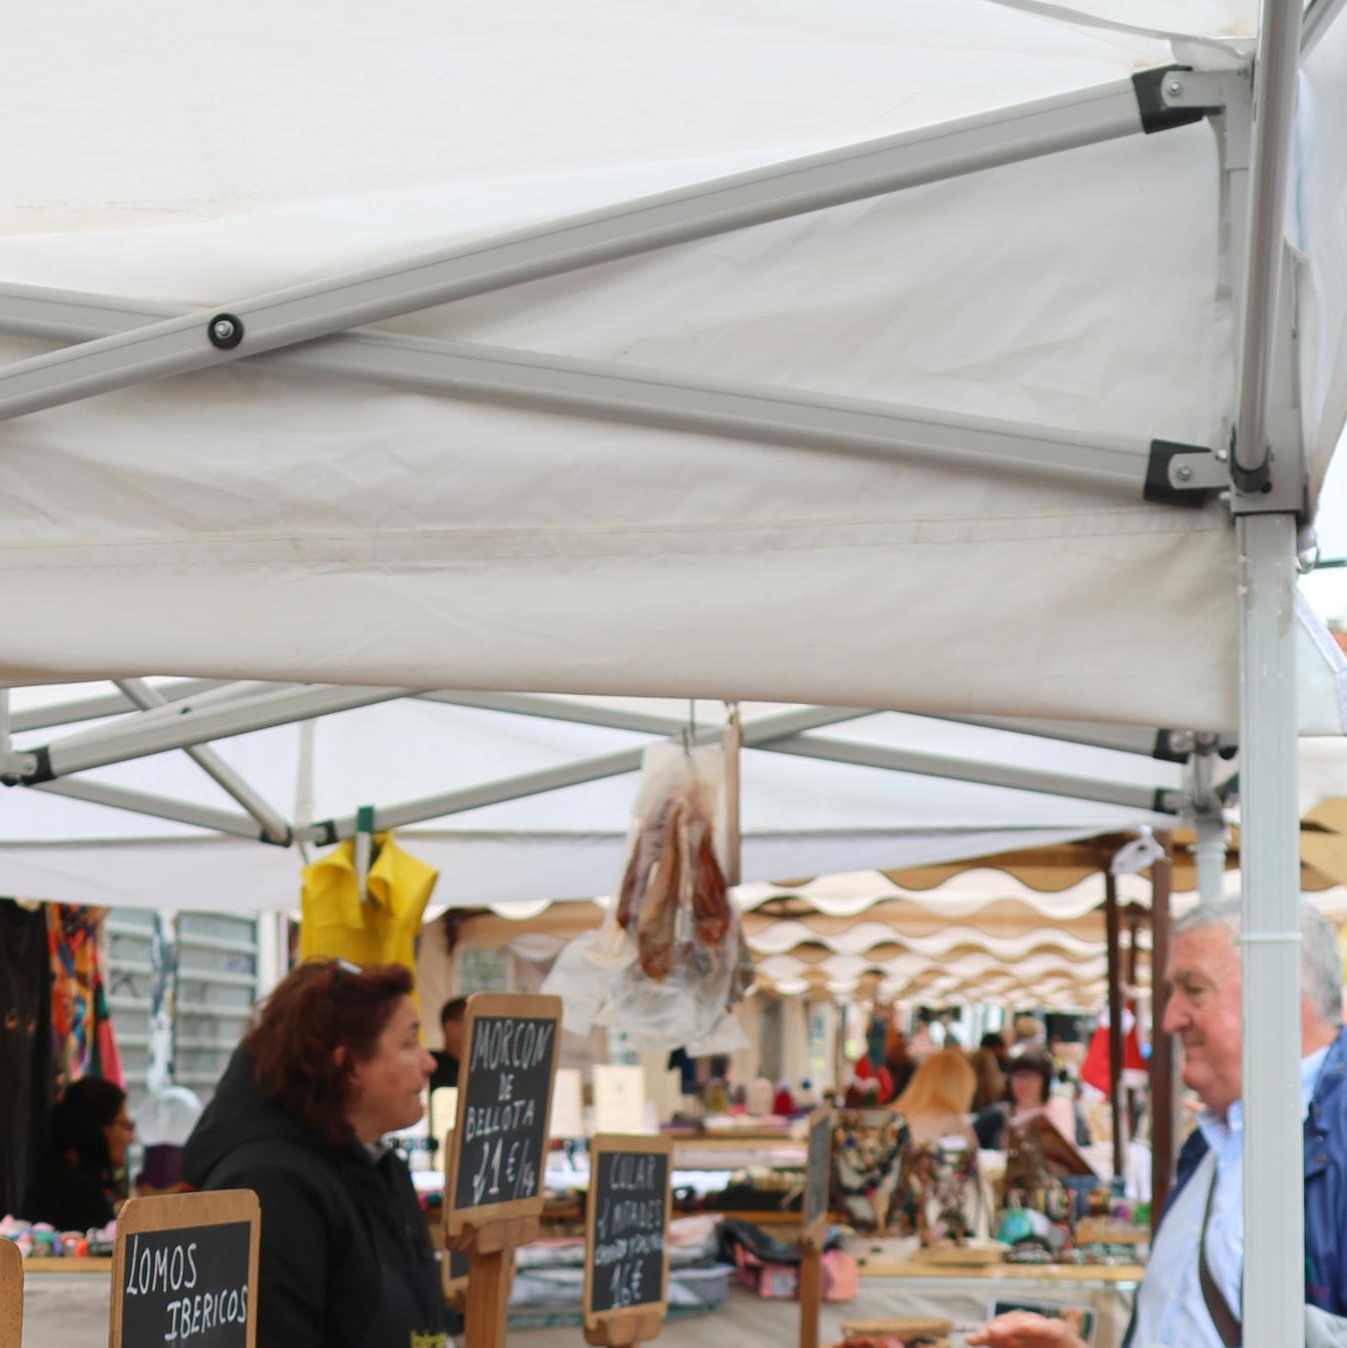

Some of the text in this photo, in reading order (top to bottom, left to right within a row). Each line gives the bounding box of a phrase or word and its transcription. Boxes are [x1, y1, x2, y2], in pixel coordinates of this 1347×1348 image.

[471, 1019, 554, 1072] MORCON
[498, 1072, 515, 1101] DE
[466, 1099, 536, 1143] BELLOTA
[126, 1234, 197, 1295] LOMOS
[164, 1284, 248, 1341] IBERICOS
